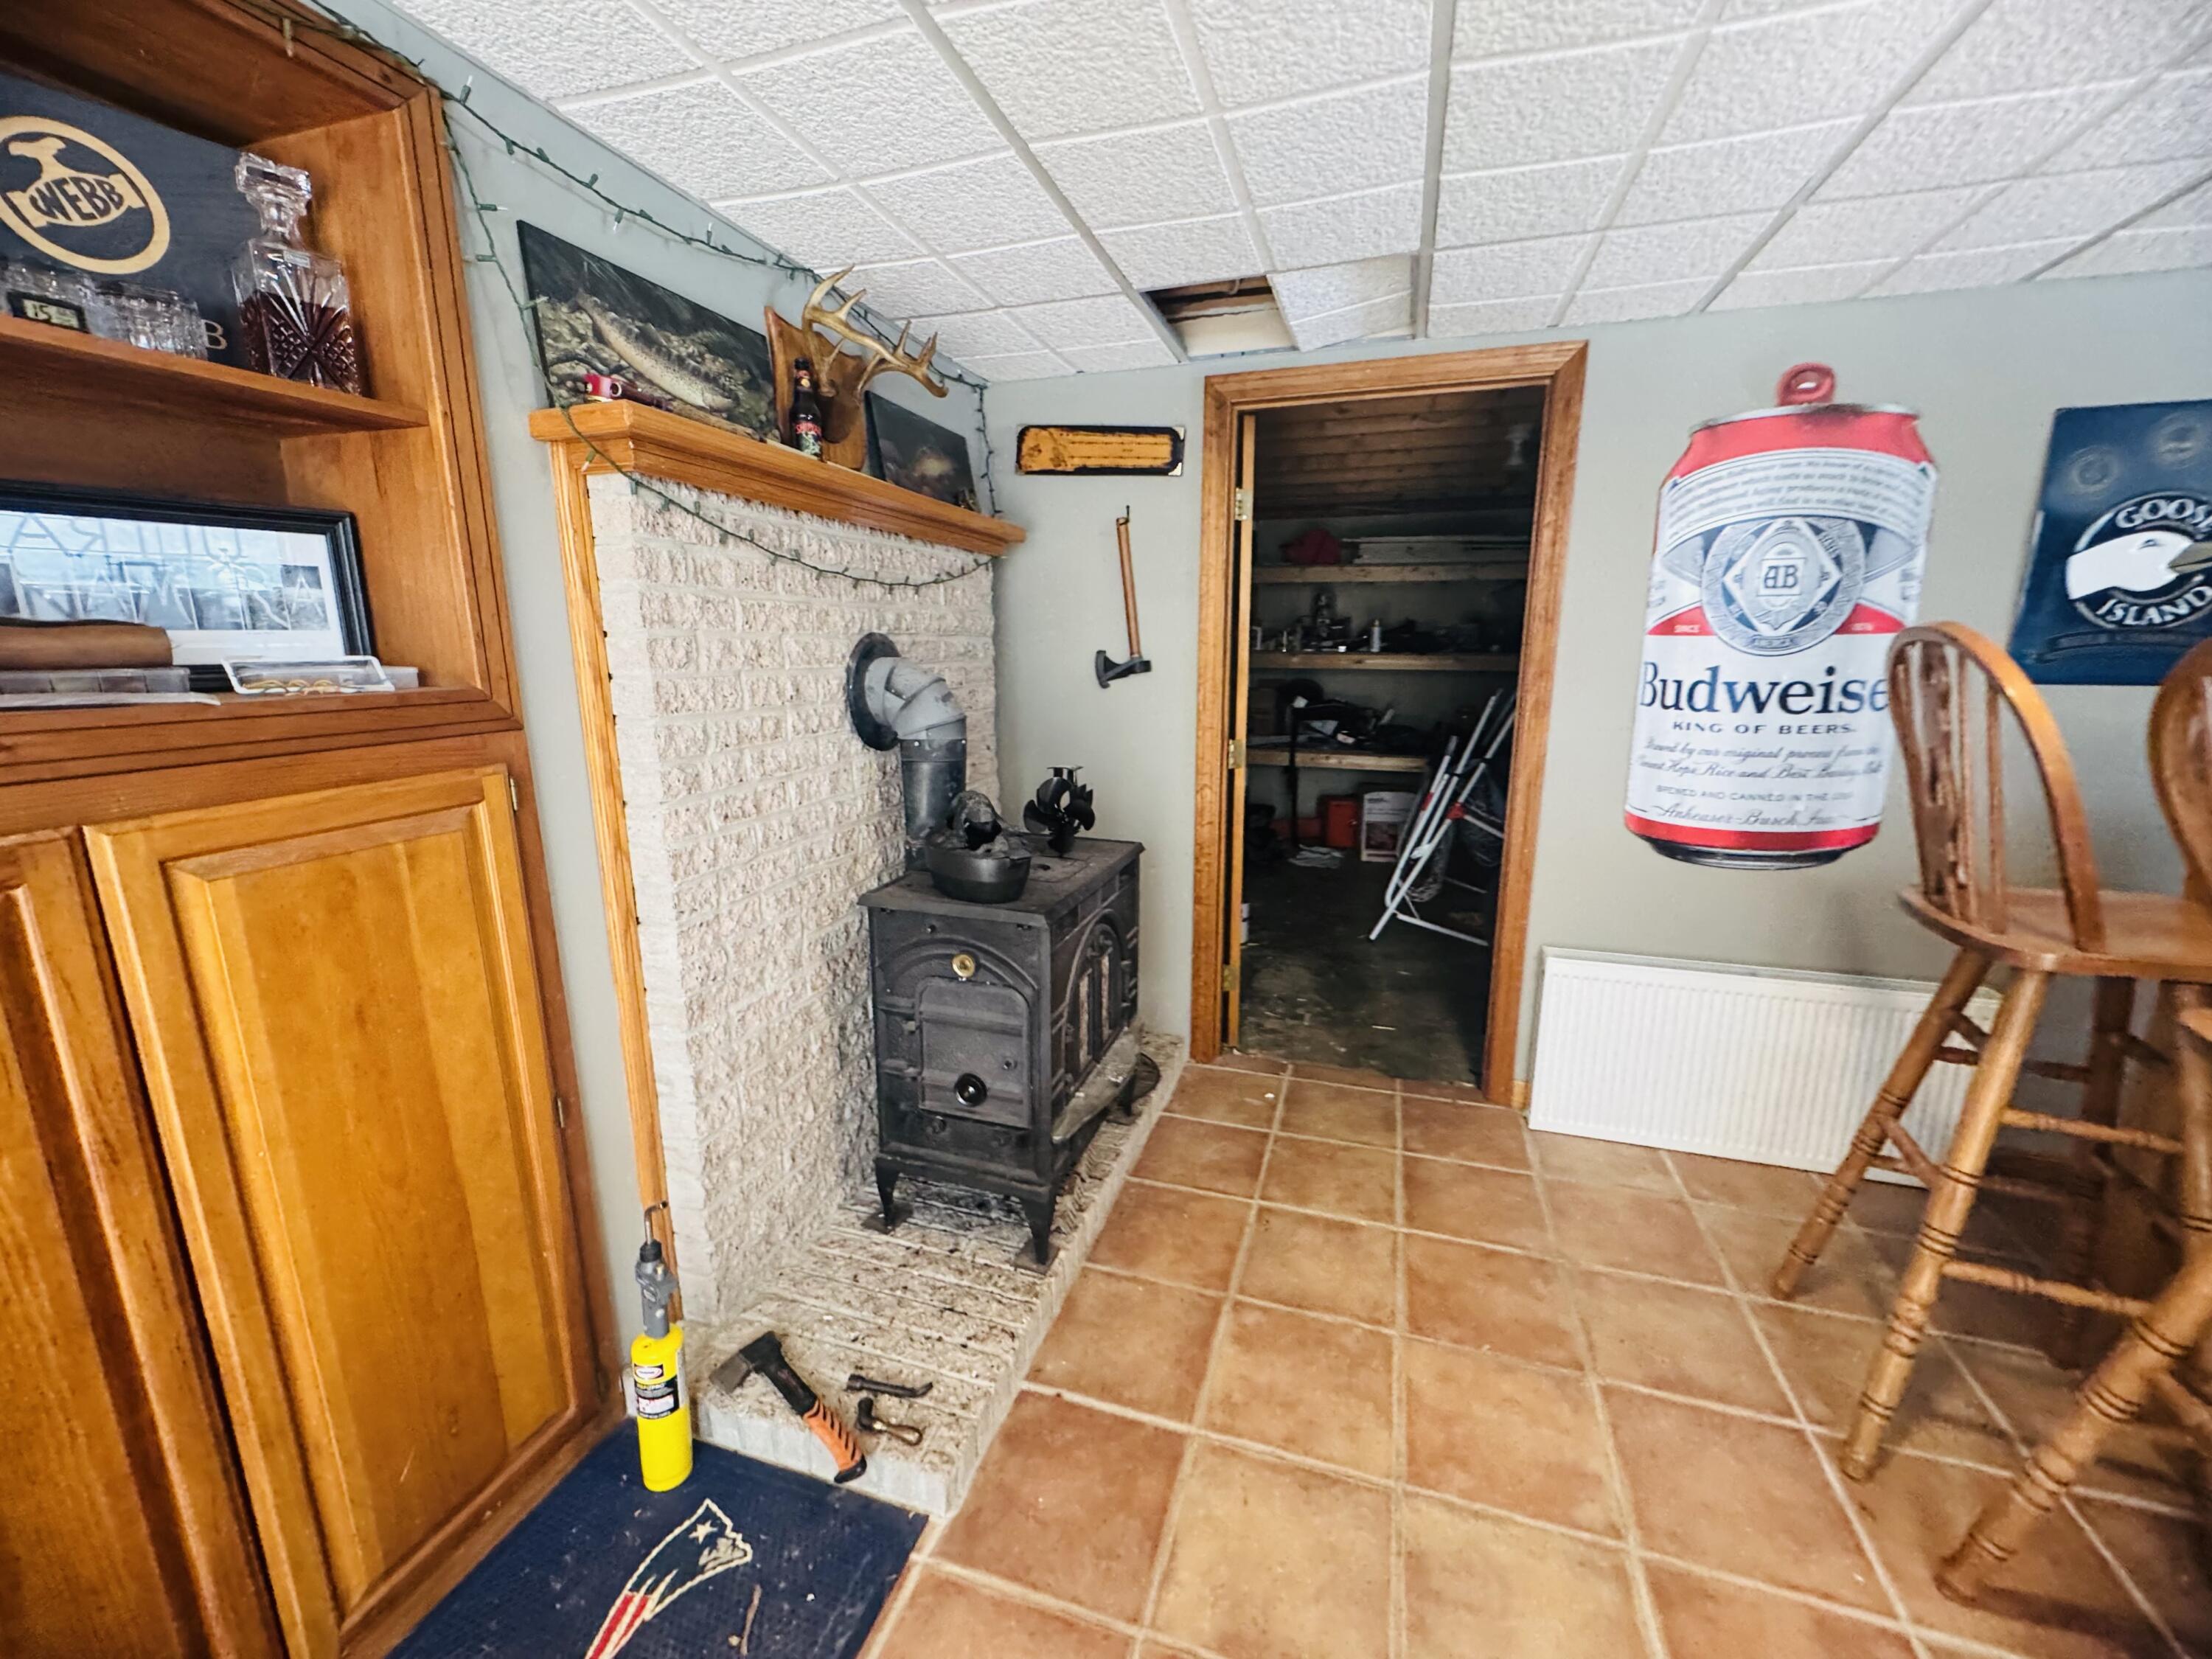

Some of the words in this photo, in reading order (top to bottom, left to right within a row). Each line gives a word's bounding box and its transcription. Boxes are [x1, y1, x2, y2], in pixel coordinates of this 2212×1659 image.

[29, 176, 125, 221] WEBB
[2096, 585, 2212, 625] ISLAND
[1639, 660, 1889, 714] Budweise
[1672, 721, 1723, 733] KING
[1734, 723, 1767, 734] OF
